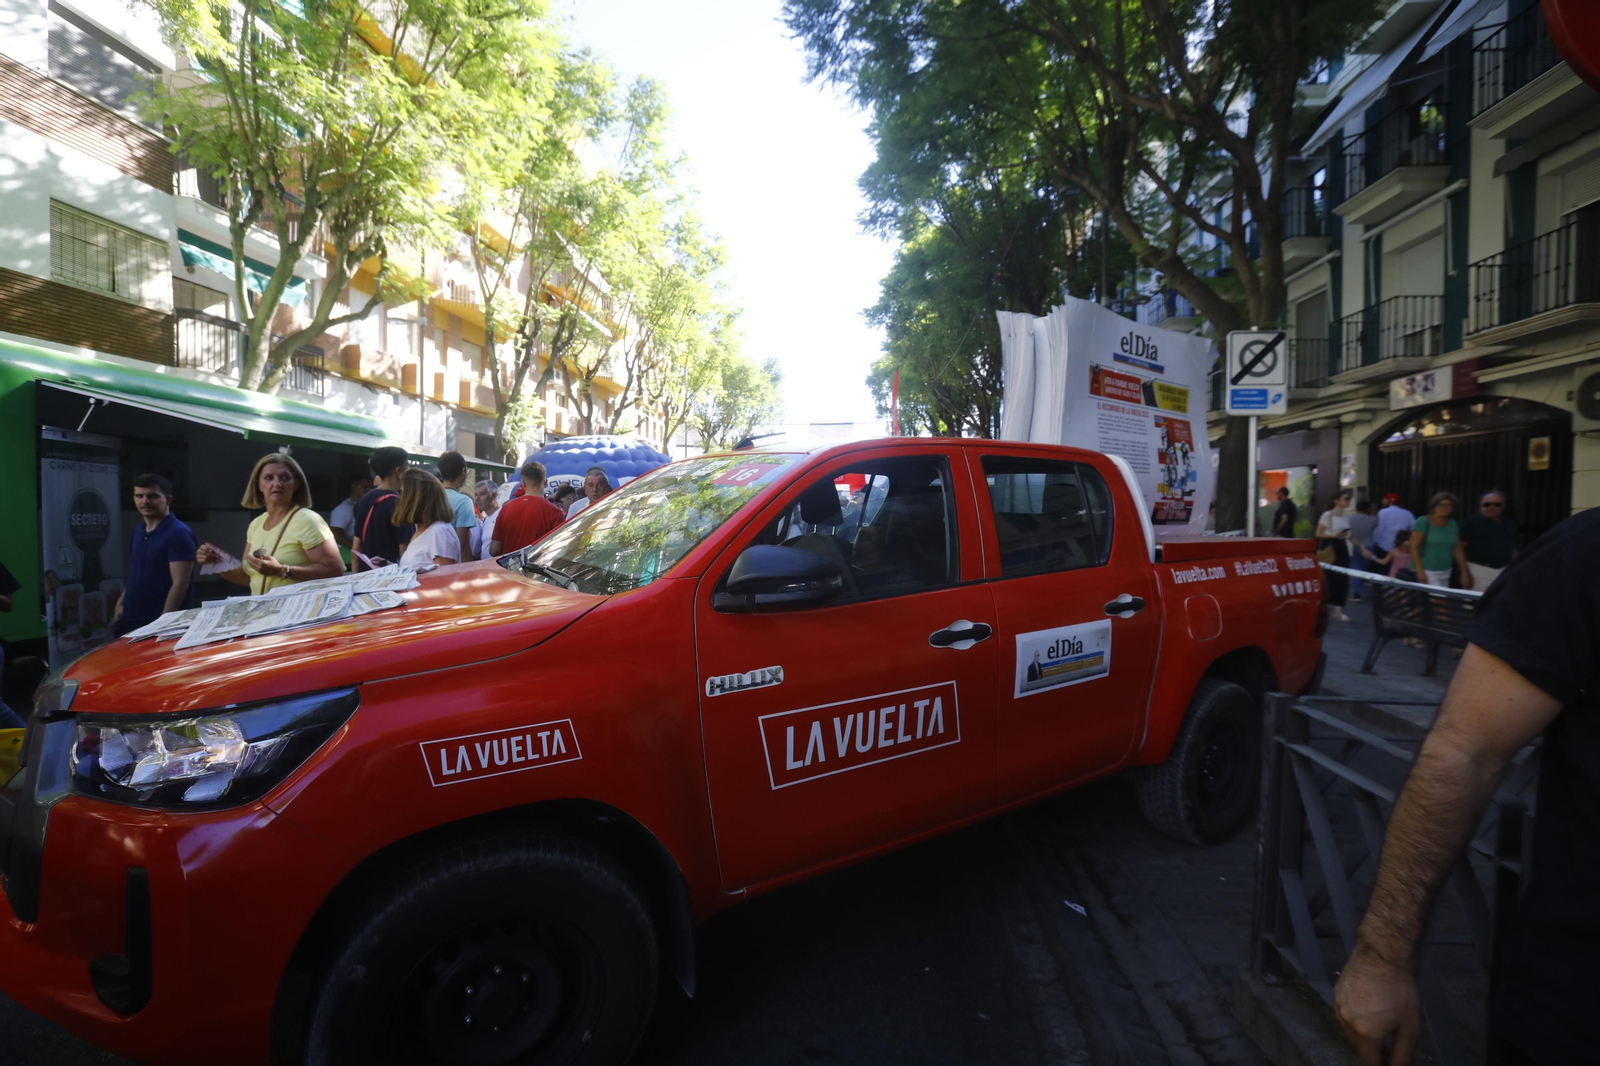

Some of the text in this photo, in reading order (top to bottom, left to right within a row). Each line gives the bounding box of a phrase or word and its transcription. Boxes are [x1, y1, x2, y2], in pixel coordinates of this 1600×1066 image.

[49, 460, 77, 472] CARNE
[88, 464, 119, 476] CONEJO
[727, 467, 760, 482] 16
[70, 513, 108, 526] SECRETO
[1171, 565, 1226, 584] lavuelta.com
[708, 667, 782, 695] HILUX
[785, 696, 945, 771] LA VUELTA
[440, 729, 567, 776] LA VUELTA
